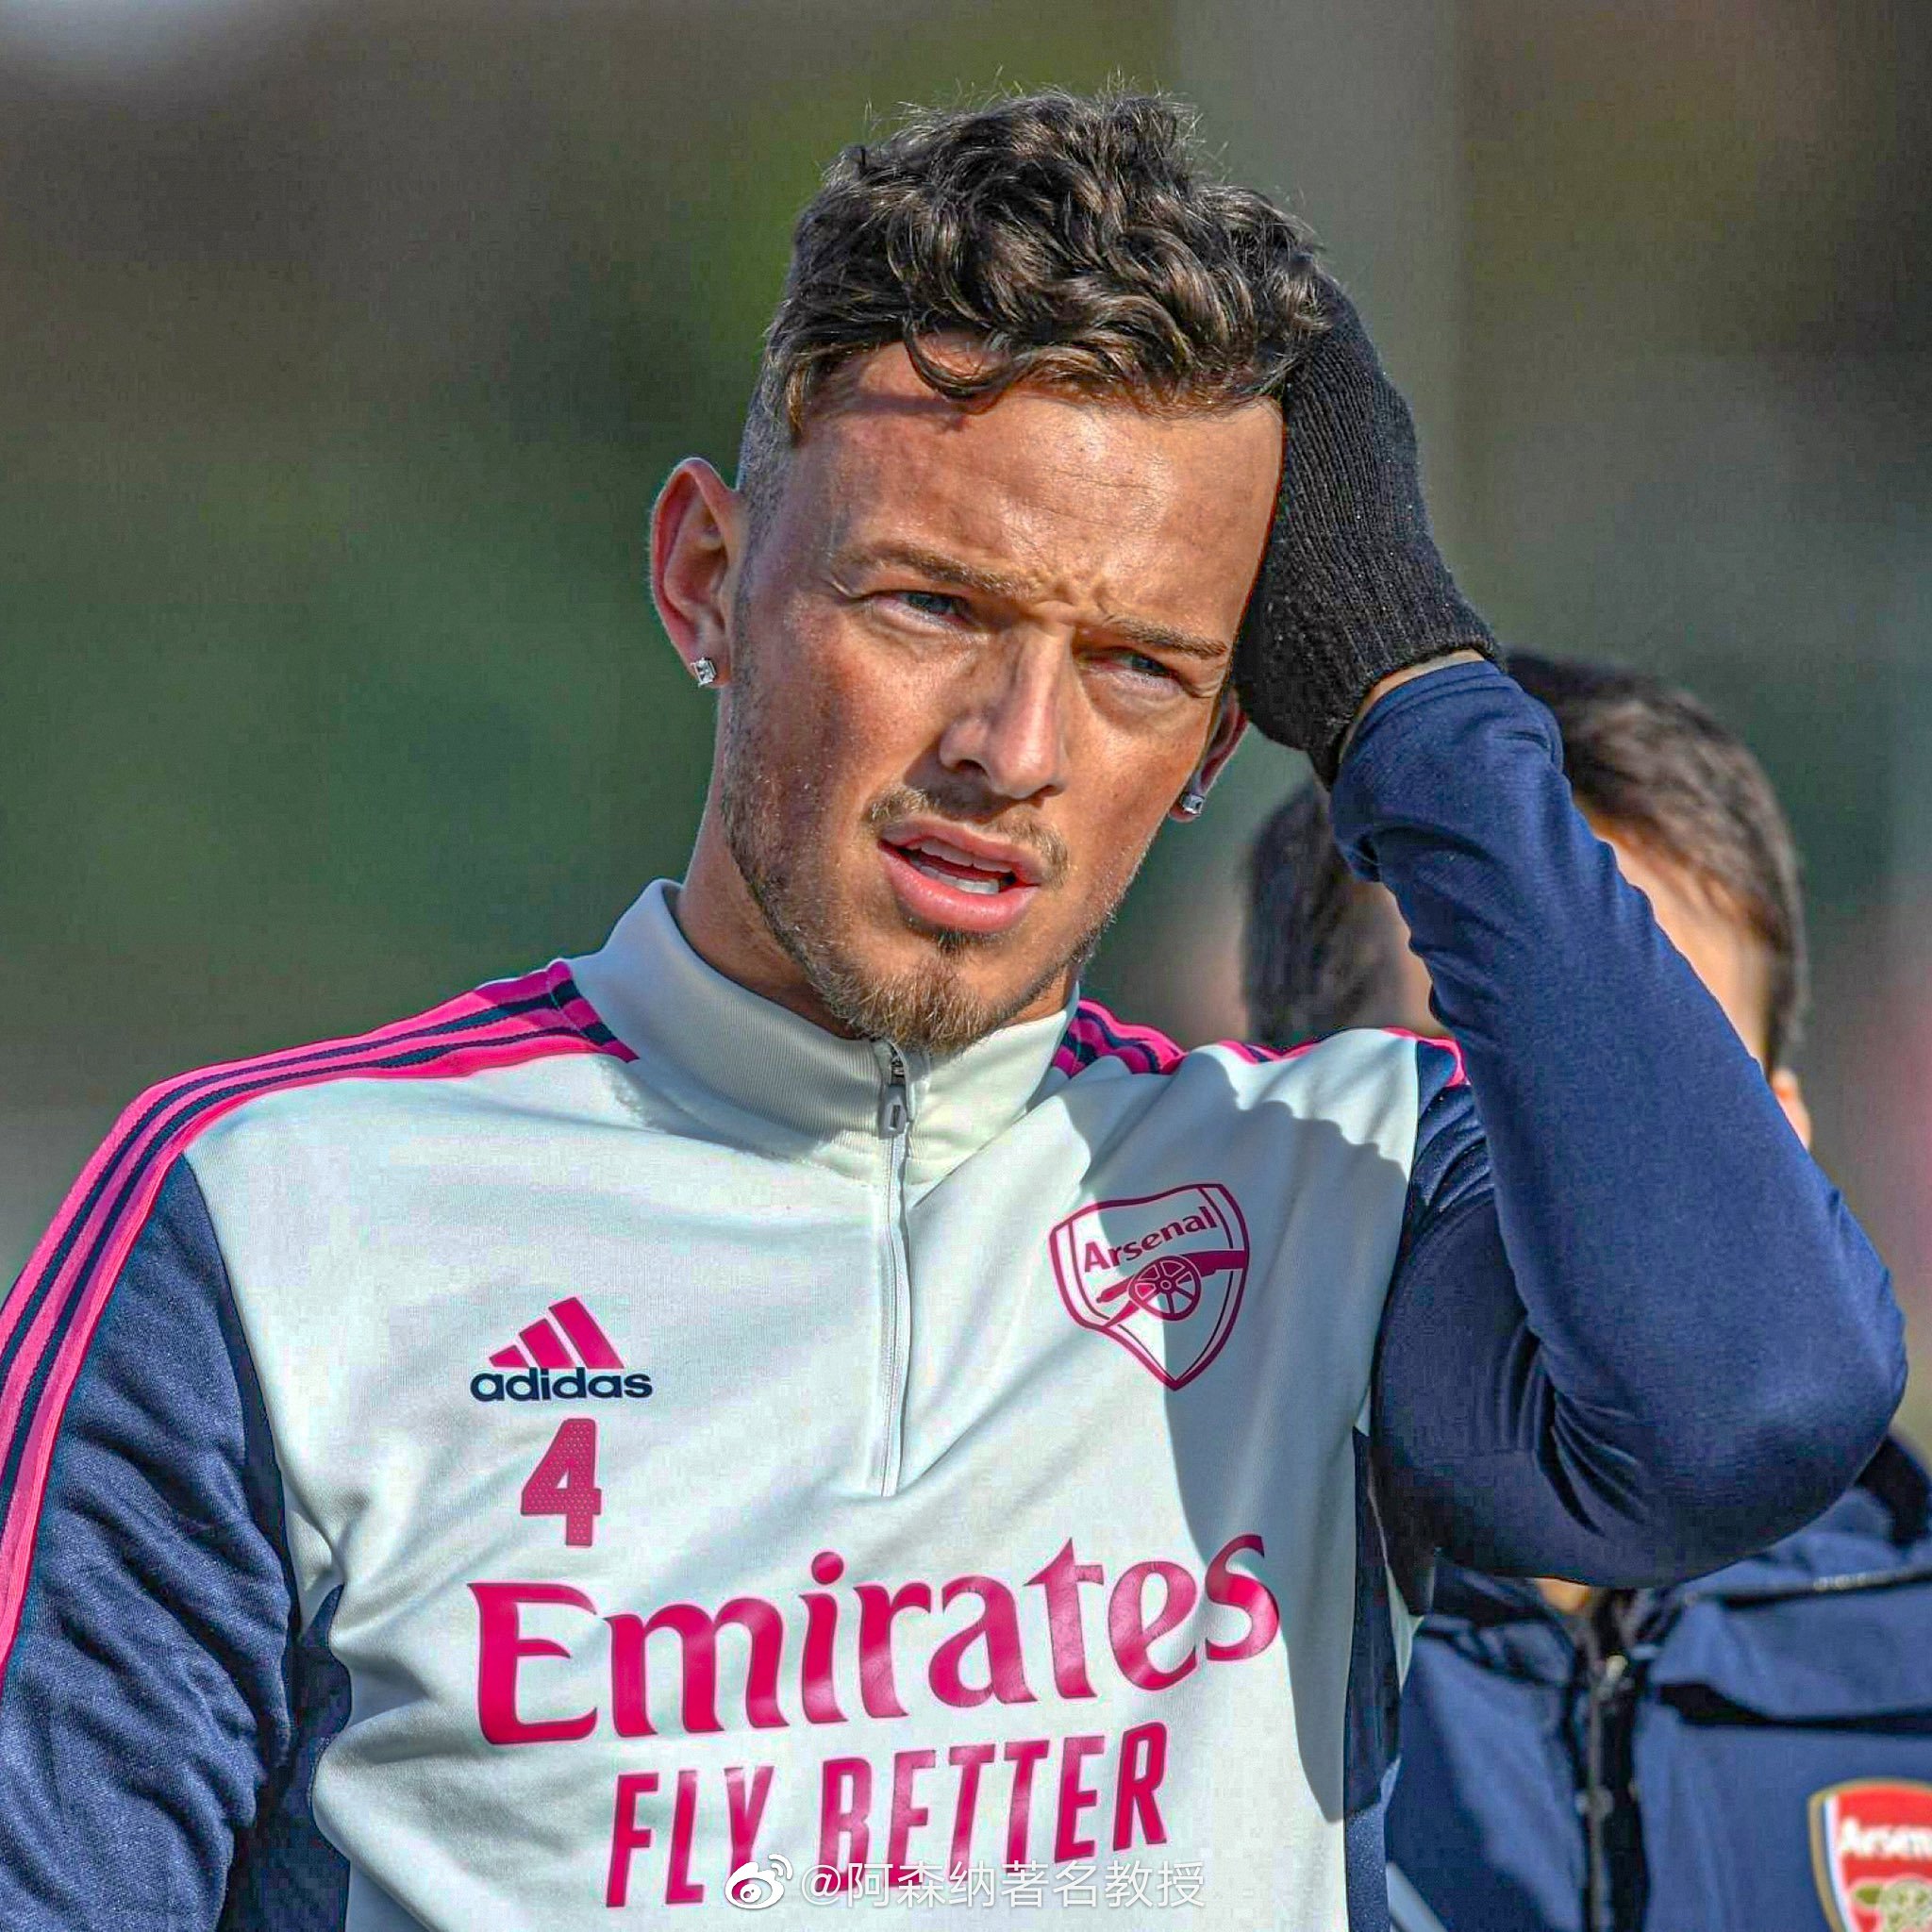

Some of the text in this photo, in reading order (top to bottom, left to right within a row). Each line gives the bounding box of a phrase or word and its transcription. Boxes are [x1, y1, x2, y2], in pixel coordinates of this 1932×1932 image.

[1084, 1206, 1217, 1273] Arsenal
[471, 1367, 653, 1402] adidas
[521, 1418, 602, 1547] 4
[467, 1534, 1279, 1745] Emirates
[606, 1721, 1169, 1907] FLY BETTER
